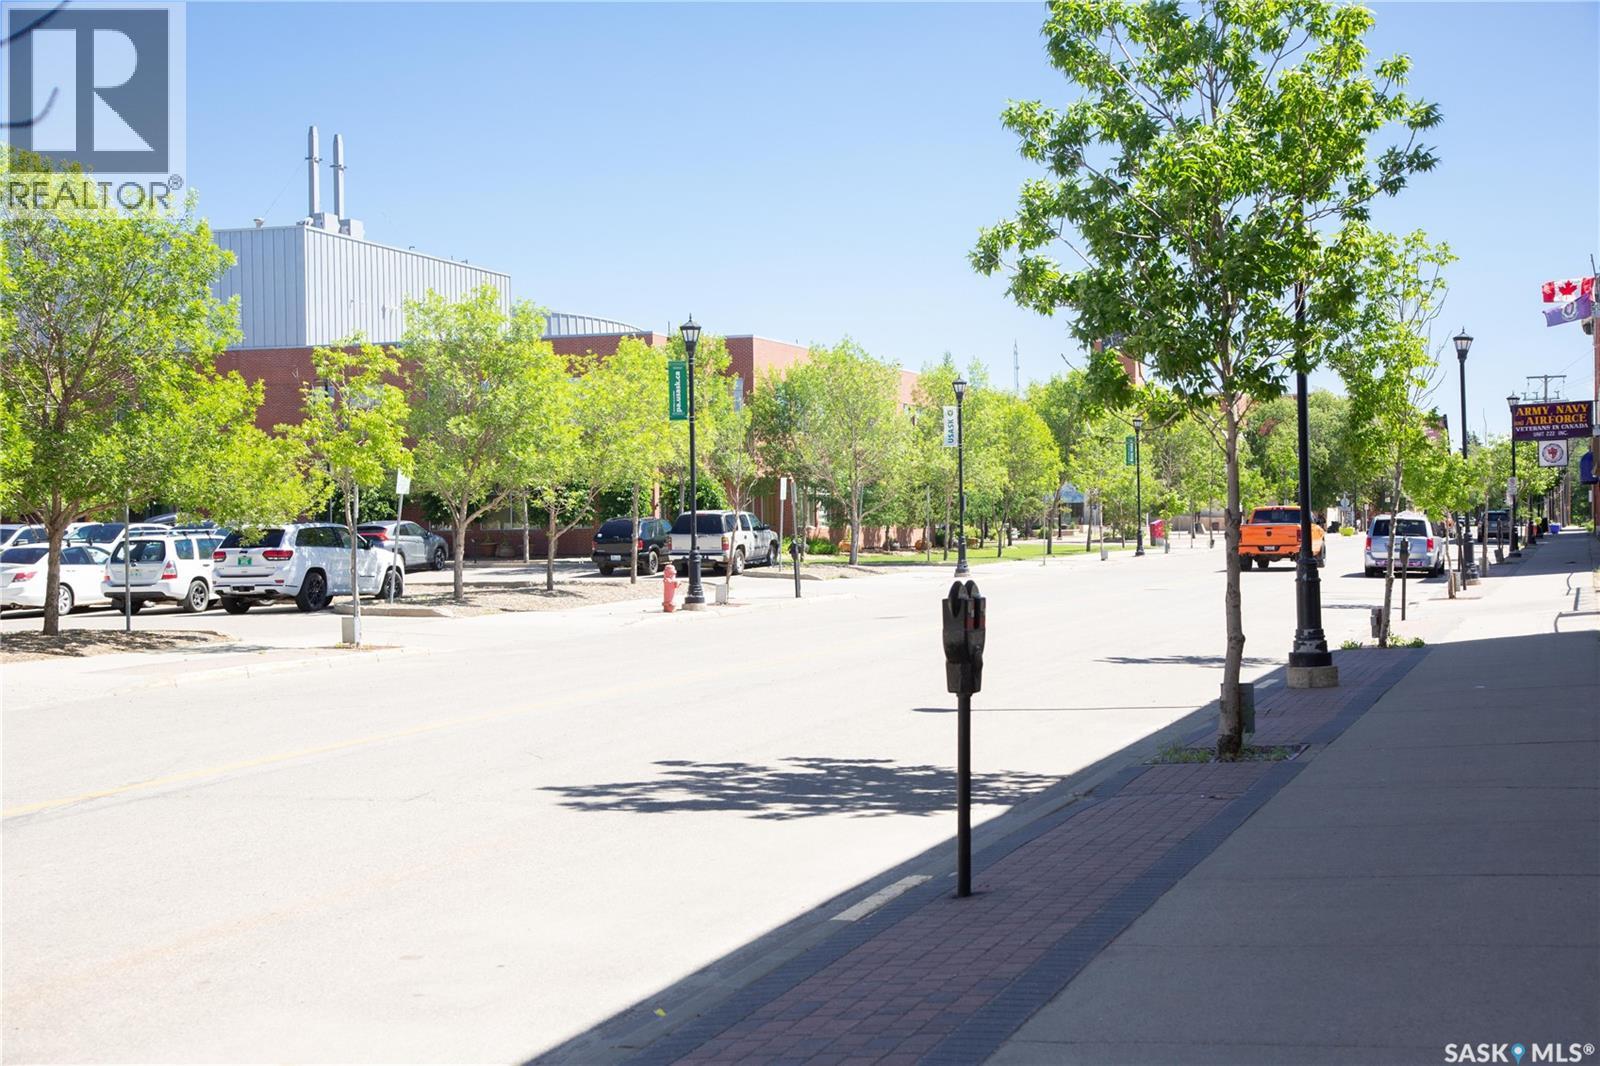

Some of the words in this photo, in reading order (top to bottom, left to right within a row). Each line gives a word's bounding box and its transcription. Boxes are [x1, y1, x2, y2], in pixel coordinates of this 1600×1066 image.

[1556, 404, 1588, 413] NAVY
[1526, 414, 1587, 425] AIRFORCE
[1515, 424, 1550, 432] VETERANS
